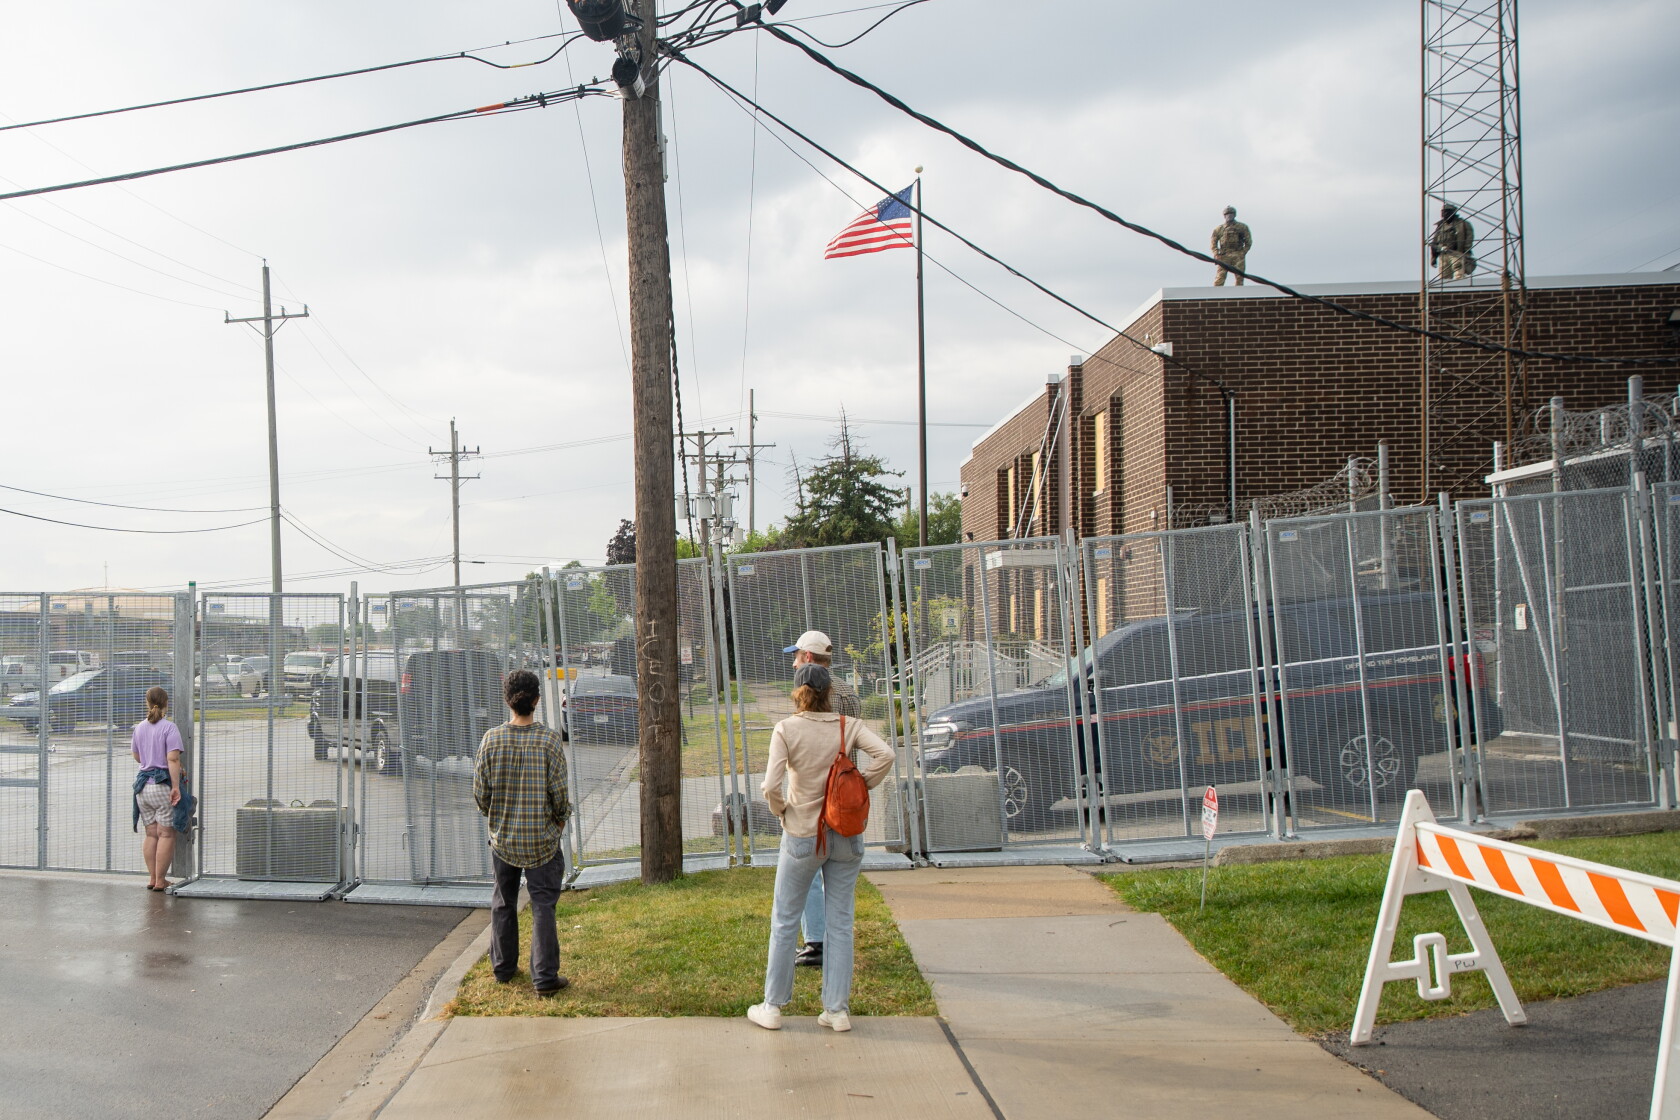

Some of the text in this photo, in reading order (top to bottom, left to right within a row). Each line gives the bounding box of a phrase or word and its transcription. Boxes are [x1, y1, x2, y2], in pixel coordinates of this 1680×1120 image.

[641, 619, 665, 743] ICE OUT
[1345, 653, 1438, 670] DEFND THE HOMELAND
